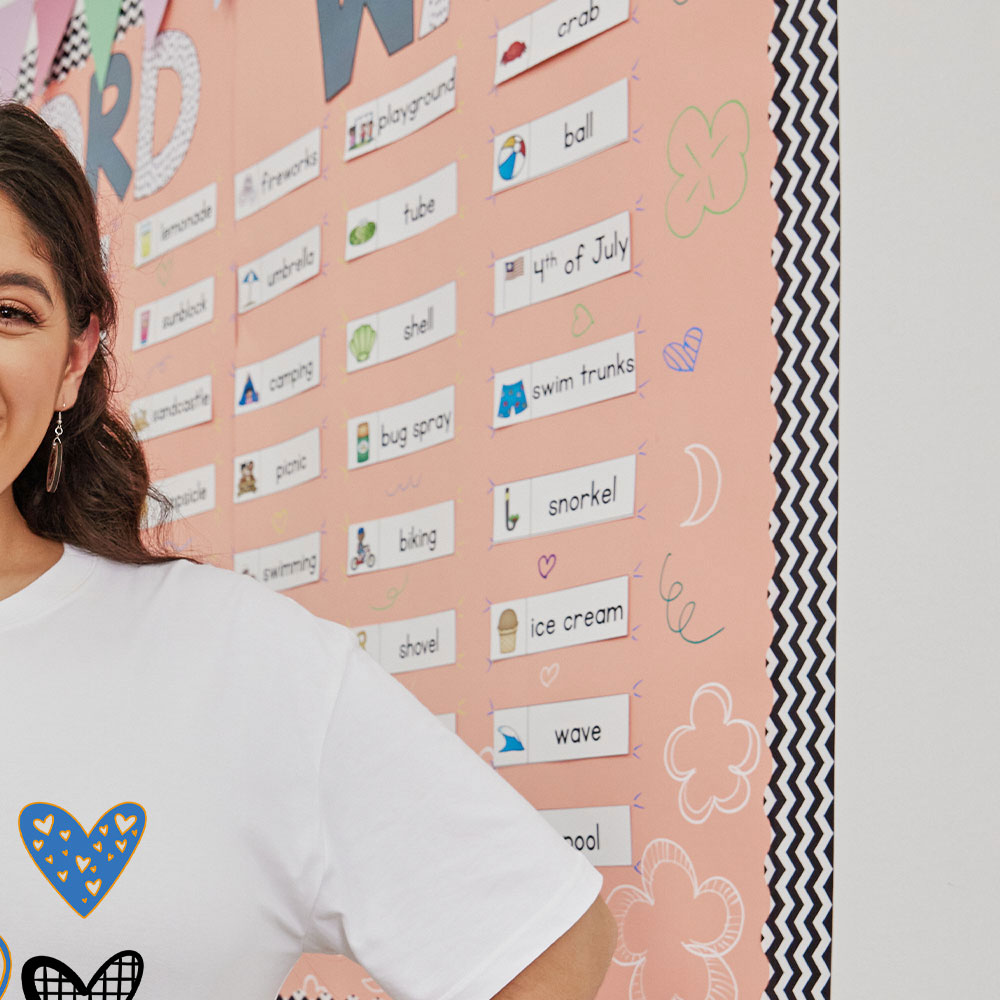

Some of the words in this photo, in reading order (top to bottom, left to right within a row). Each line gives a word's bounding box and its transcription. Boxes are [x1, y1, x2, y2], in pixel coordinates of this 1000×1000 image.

[557, 0, 600, 38] crab
[377, 66, 457, 136] playground
[564, 111, 594, 150] ball
[261, 148, 318, 194] fireworks
[161, 202, 213, 241] lemonade
[404, 195, 436, 225] tube
[267, 247, 315, 287] umbrella
[533, 250, 557, 284] 4th
[564, 243, 585, 276] of
[592, 230, 629, 265] July
[403, 306, 434, 341] shell
[269, 361, 314, 392] camping
[532, 376, 575, 400] swim
[580, 353, 636, 386] trunks
[381, 424, 408, 449] bug
[412, 410, 453, 443] spray
[276, 455, 308, 485] picnic
[548, 475, 617, 517] snorkel
[399, 527, 438, 552] biking
[263, 554, 318, 584] swimming
[530, 616, 557, 638] ice
[563, 603, 624, 631] cream
[399, 628, 440, 660] shovel
[554, 723, 602, 746] wave
